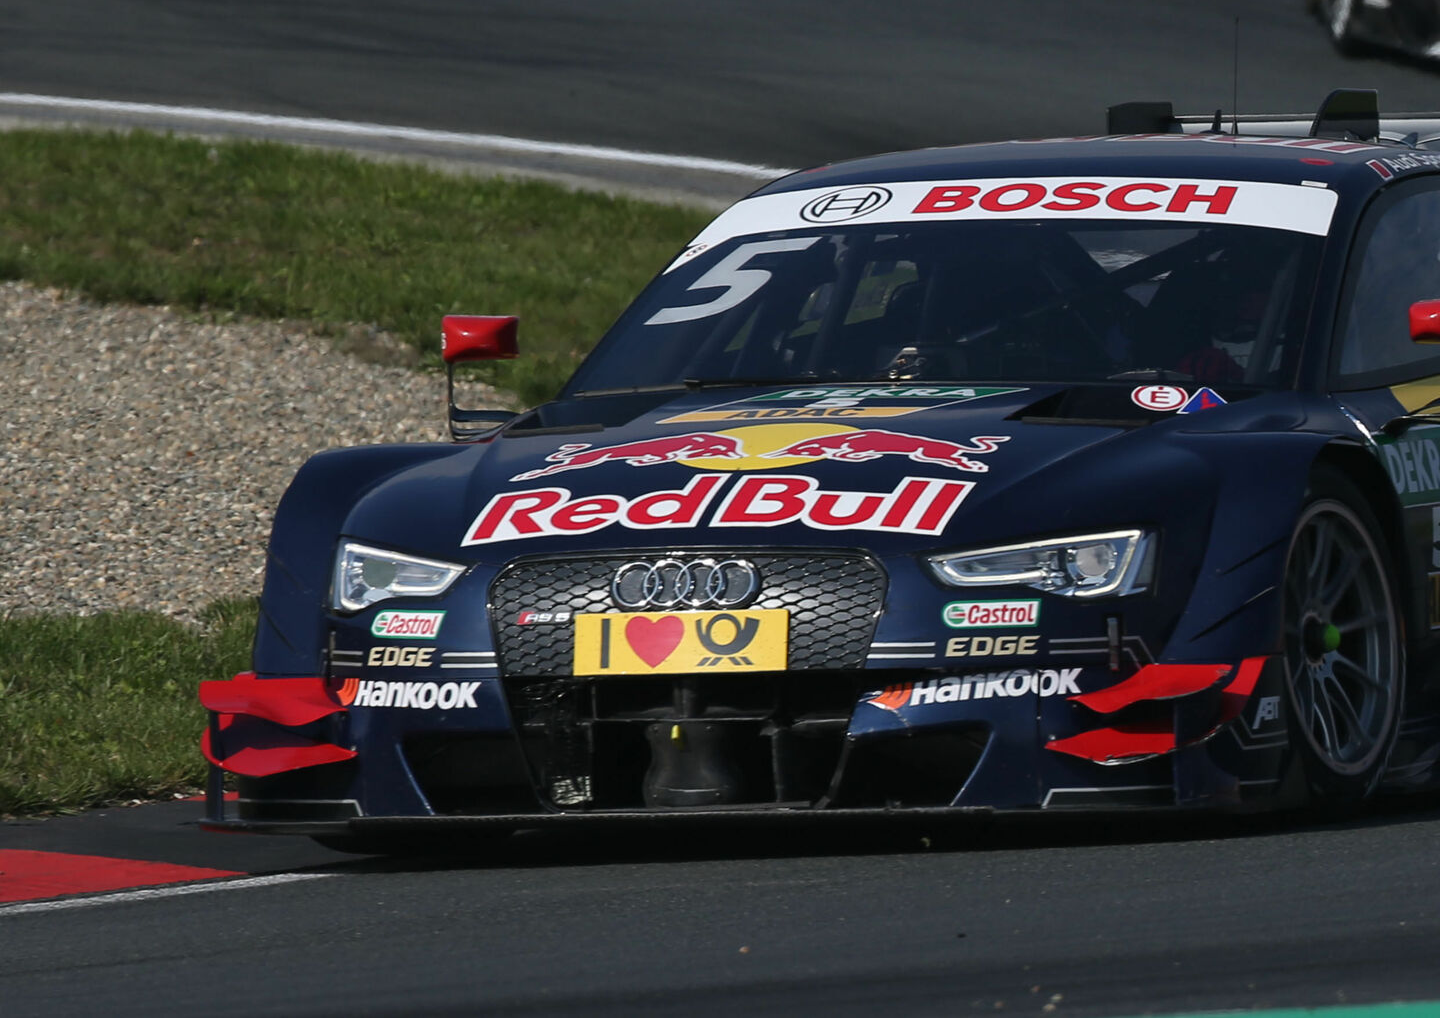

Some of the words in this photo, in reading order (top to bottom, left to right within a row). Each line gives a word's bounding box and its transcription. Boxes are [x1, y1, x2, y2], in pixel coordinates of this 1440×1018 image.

[910, 182, 1239, 215] BOSCH
[643, 236, 823, 326] 5
[780, 388, 977, 398] DEKRA
[724, 408, 865, 419] ADAC
[462, 473, 731, 547] Red
[709, 474, 977, 536] Bull
[386, 613, 439, 637] Castrol
[966, 602, 1037, 626] Castrol
[600, 618, 611, 669] I
[944, 635, 1042, 658] EDGE
[367, 647, 438, 668] EDGE
